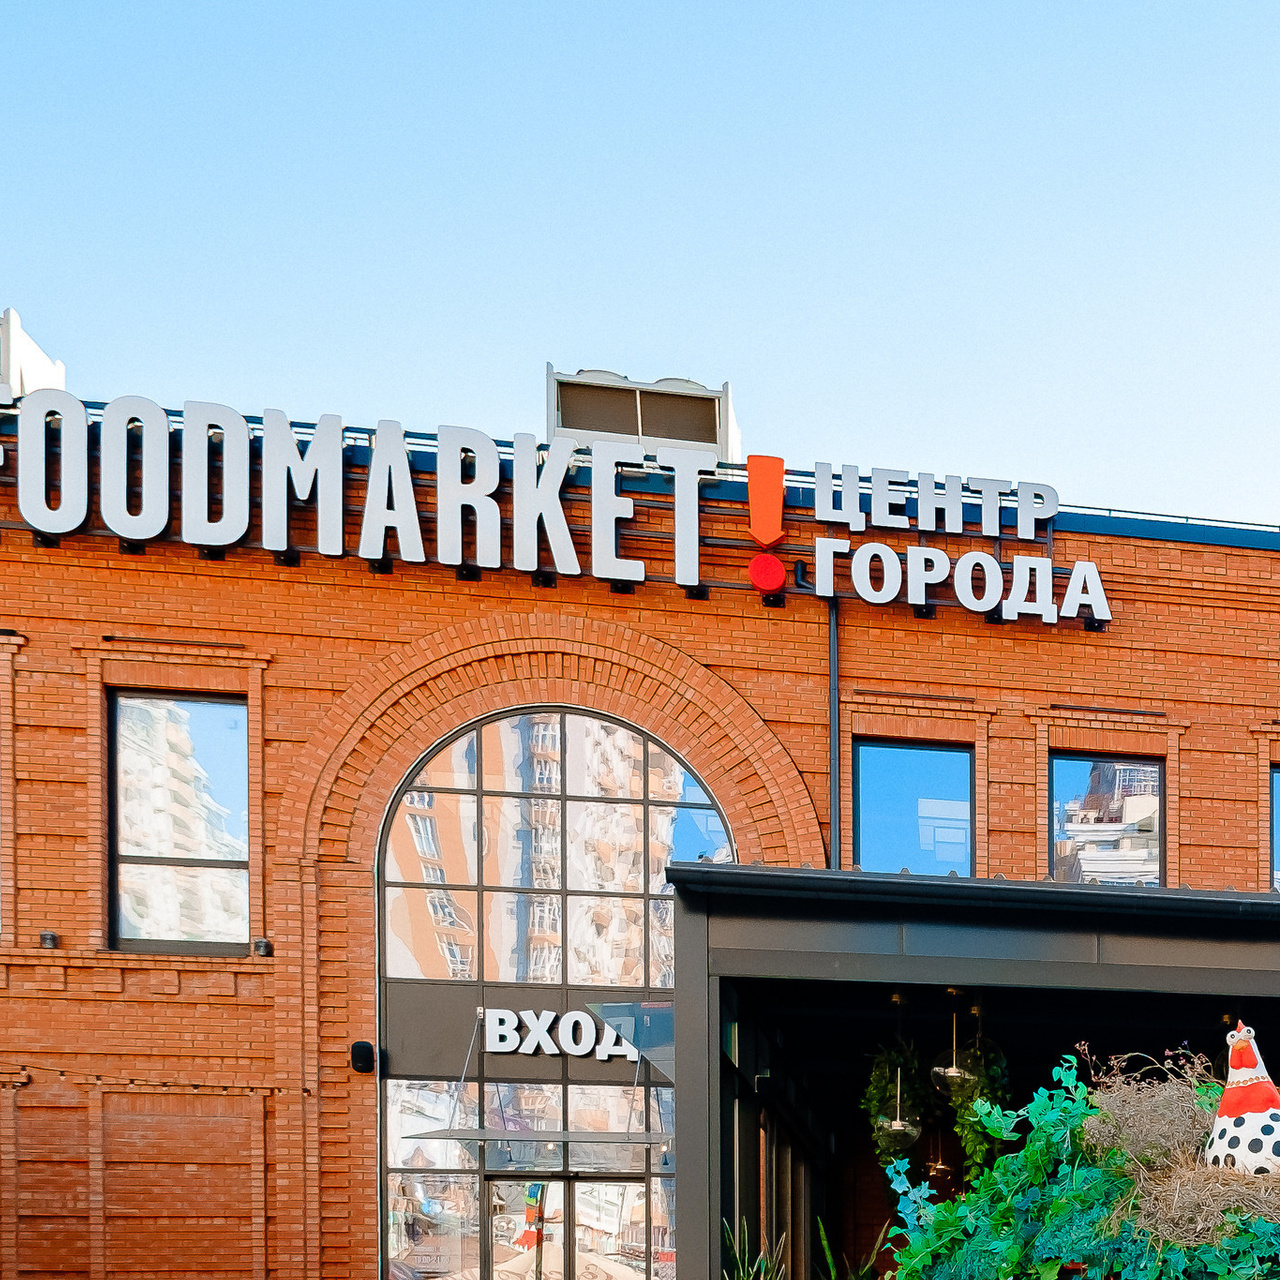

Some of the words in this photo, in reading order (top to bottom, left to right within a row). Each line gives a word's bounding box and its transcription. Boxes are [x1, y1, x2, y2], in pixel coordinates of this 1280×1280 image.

[0, 384, 718, 587] OODMARKET
[814, 461, 1060, 541] ЦЕНТР
[814, 536, 1112, 625] ГОРОДА
[485, 1008, 640, 1062] ВХОД
